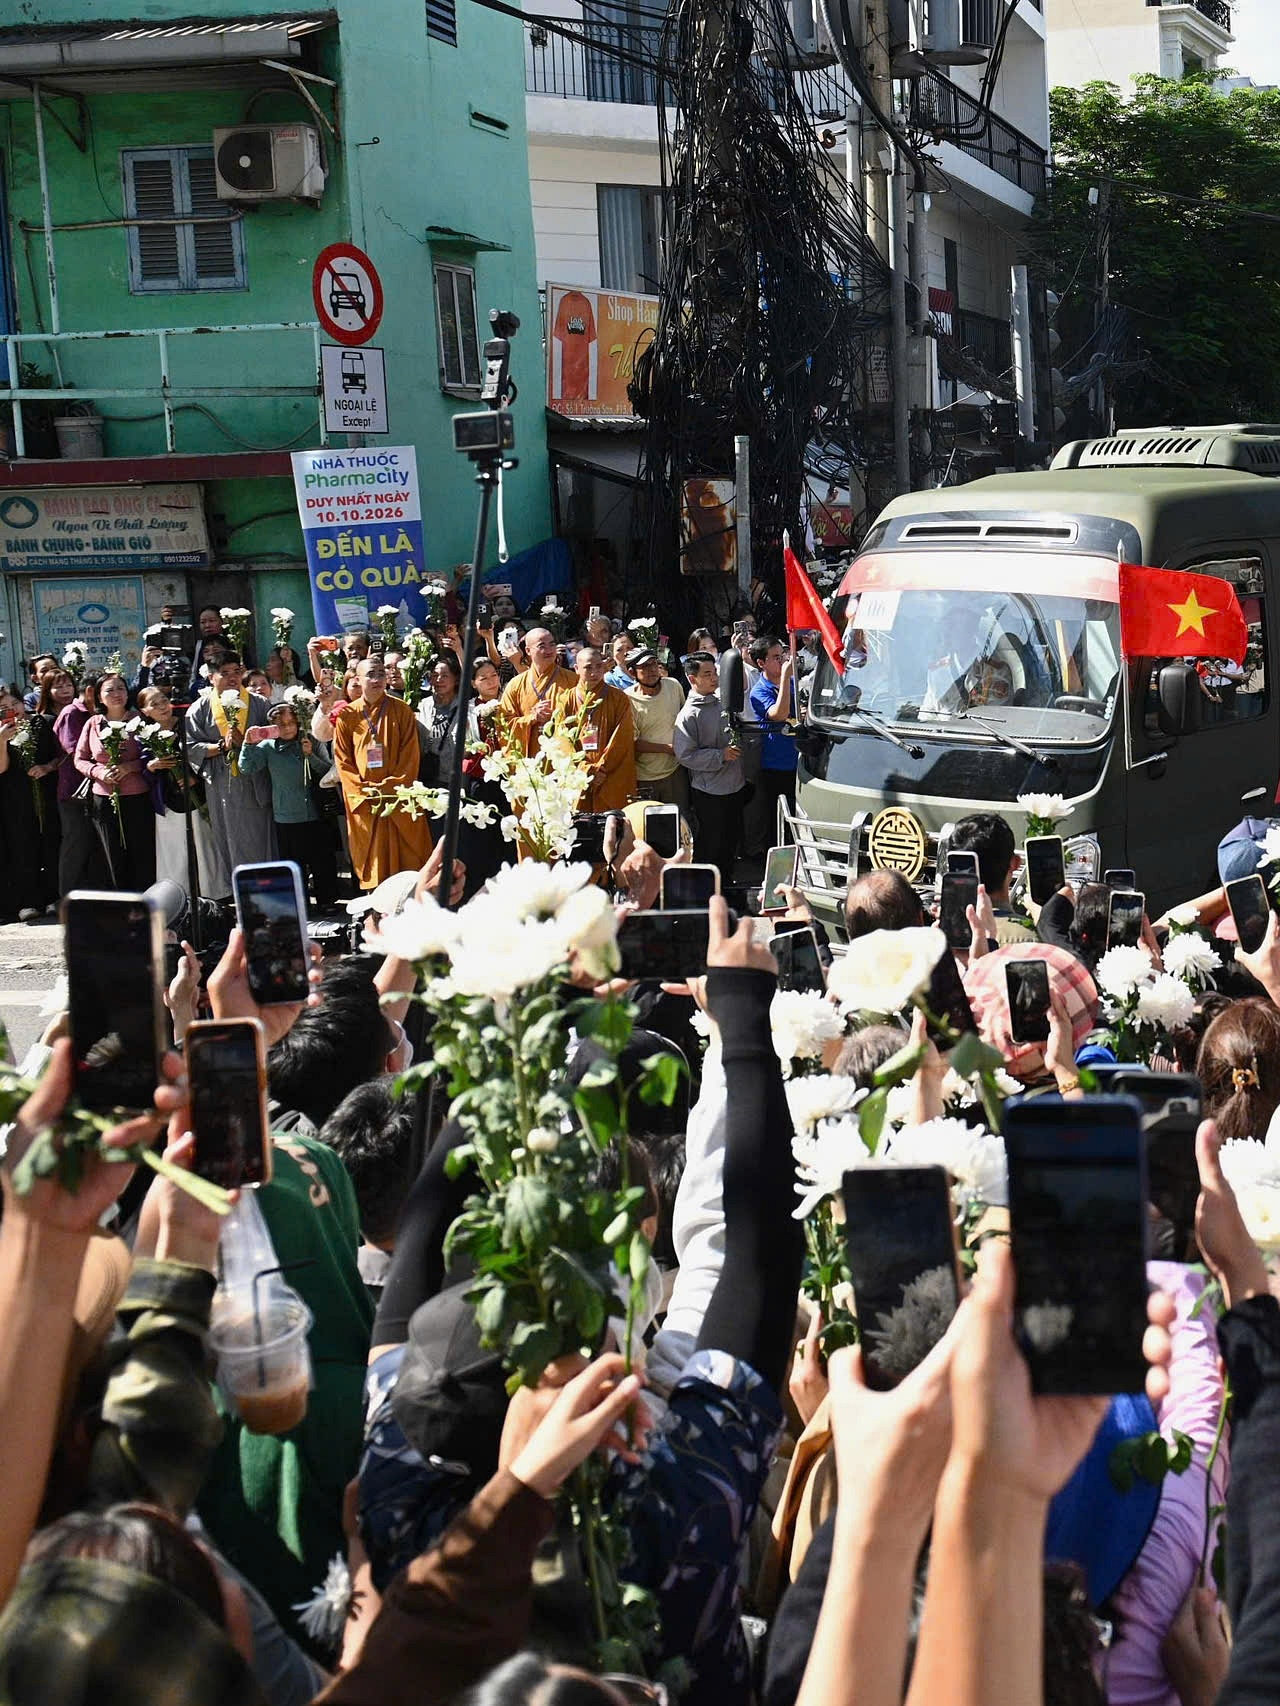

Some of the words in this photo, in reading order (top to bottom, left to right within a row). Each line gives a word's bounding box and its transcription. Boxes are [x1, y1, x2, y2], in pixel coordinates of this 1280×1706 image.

[607, 295, 633, 327] Shop
[334, 399, 363, 413] NGOẠI
[366, 398, 377, 414] LỆ
[343, 415, 371, 429] Except
[312, 456, 344, 470] NHÀ
[347, 452, 399, 467] THUỐC
[304, 467, 409, 489] Pharmacity
[306, 497, 334, 509] DUY
[337, 491, 372, 506] NHẤT
[375, 490, 410, 504] NGÀY
[316, 507, 404, 524] 10.10.2026
[316, 529, 372, 560] ĐẾN
[380, 528, 414, 555] LÀ
[315, 564, 354, 592] CÓ
[360, 559, 421, 588] QUÀ
